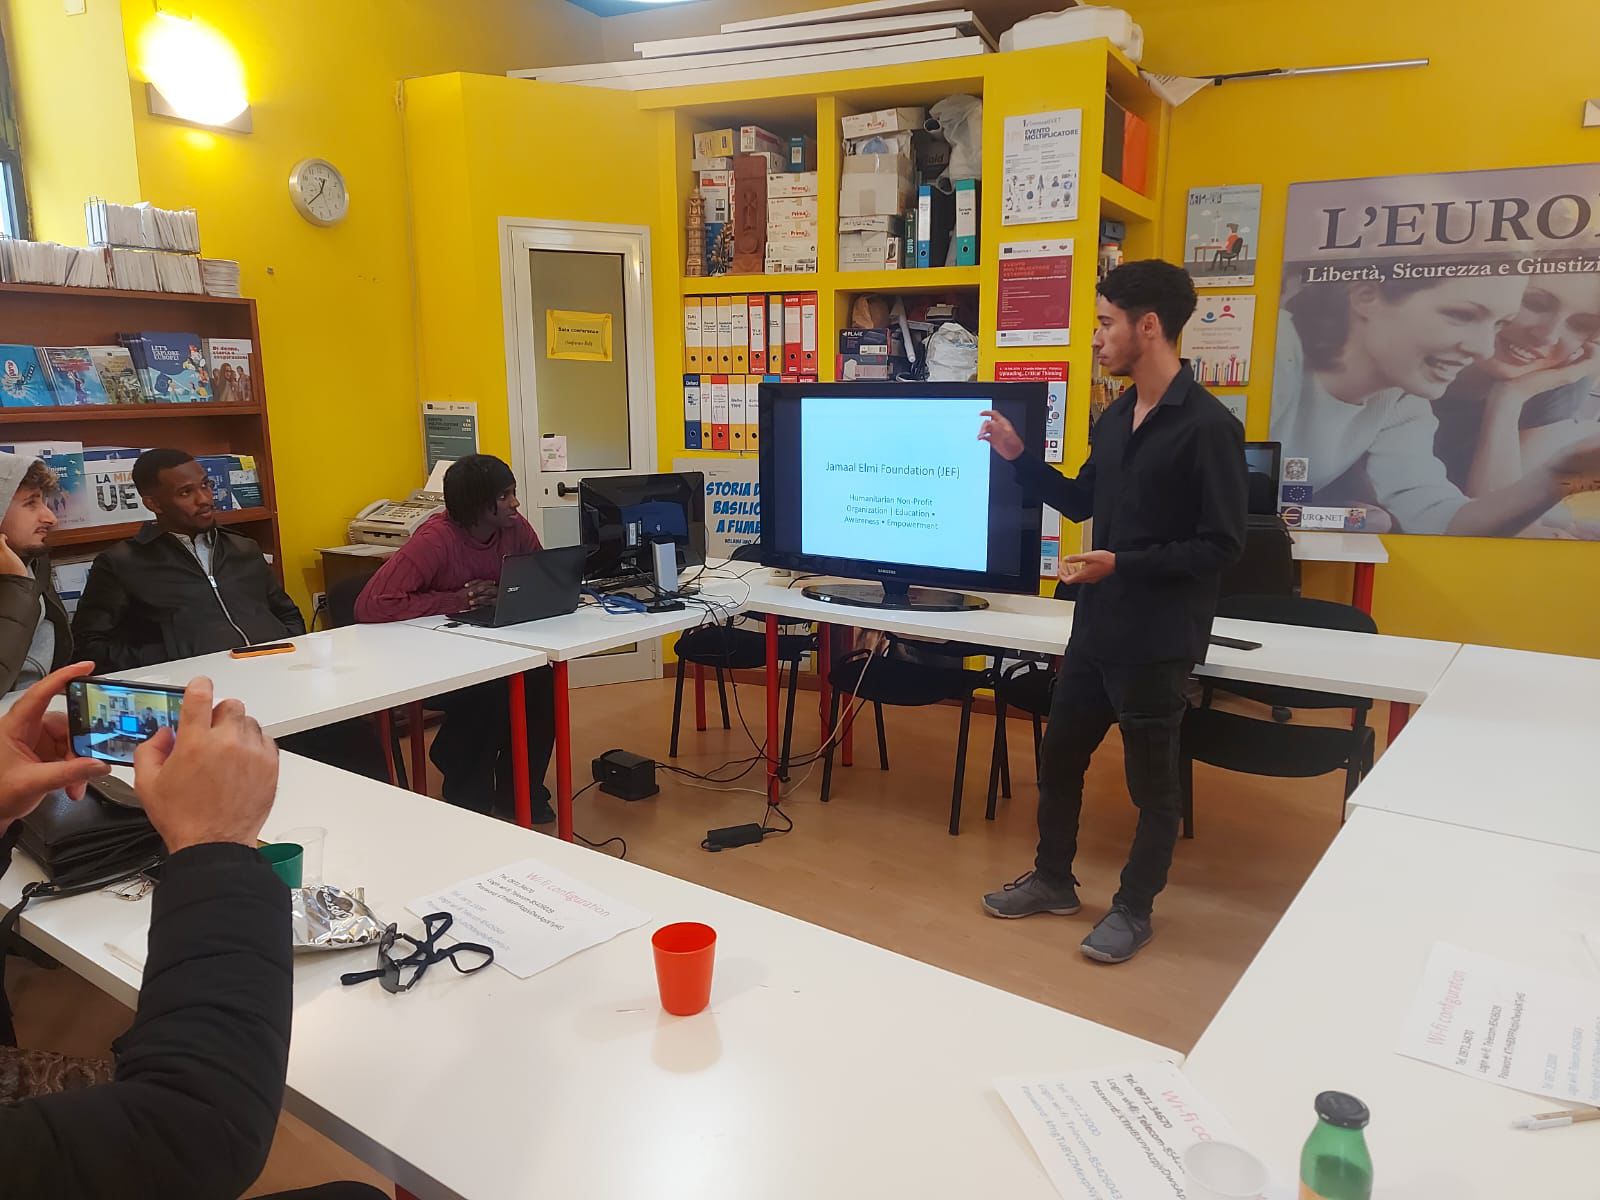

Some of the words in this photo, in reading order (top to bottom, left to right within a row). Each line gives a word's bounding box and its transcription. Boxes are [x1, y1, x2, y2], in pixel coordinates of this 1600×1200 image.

[1025, 127, 1050, 136] EVENTO
[1025, 130, 1079, 141] MOLTIPLICATORE
[1319, 194, 1600, 250] L'EURO
[1307, 264, 1386, 284] Libertà,
[1392, 261, 1492, 280] Sicurezza
[1498, 262, 1511, 275] e
[95, 474, 111, 484] LA
[825, 461, 856, 473] Jamaal
[858, 463, 878, 474] Elmi
[881, 464, 935, 477] Foundation
[937, 465, 960, 480] (JEF)
[96, 484, 139, 511] UE
[706, 481, 751, 497] STORIA
[849, 493, 895, 504] Humanitarian
[896, 496, 933, 506] Non-Profit
[846, 505, 888, 515] Organization
[895, 508, 930, 518] Education
[716, 520, 725, 533] A
[844, 516, 879, 526] Awareness
[887, 519, 939, 530] Empowerment
[547, 884, 610, 917] configuration
[1439, 969, 1466, 1024] configuration
[1090, 1080, 1121, 1114] Password:
[1106, 1078, 1125, 1097] Login
[1161, 1089, 1200, 1124] Wi-fi
